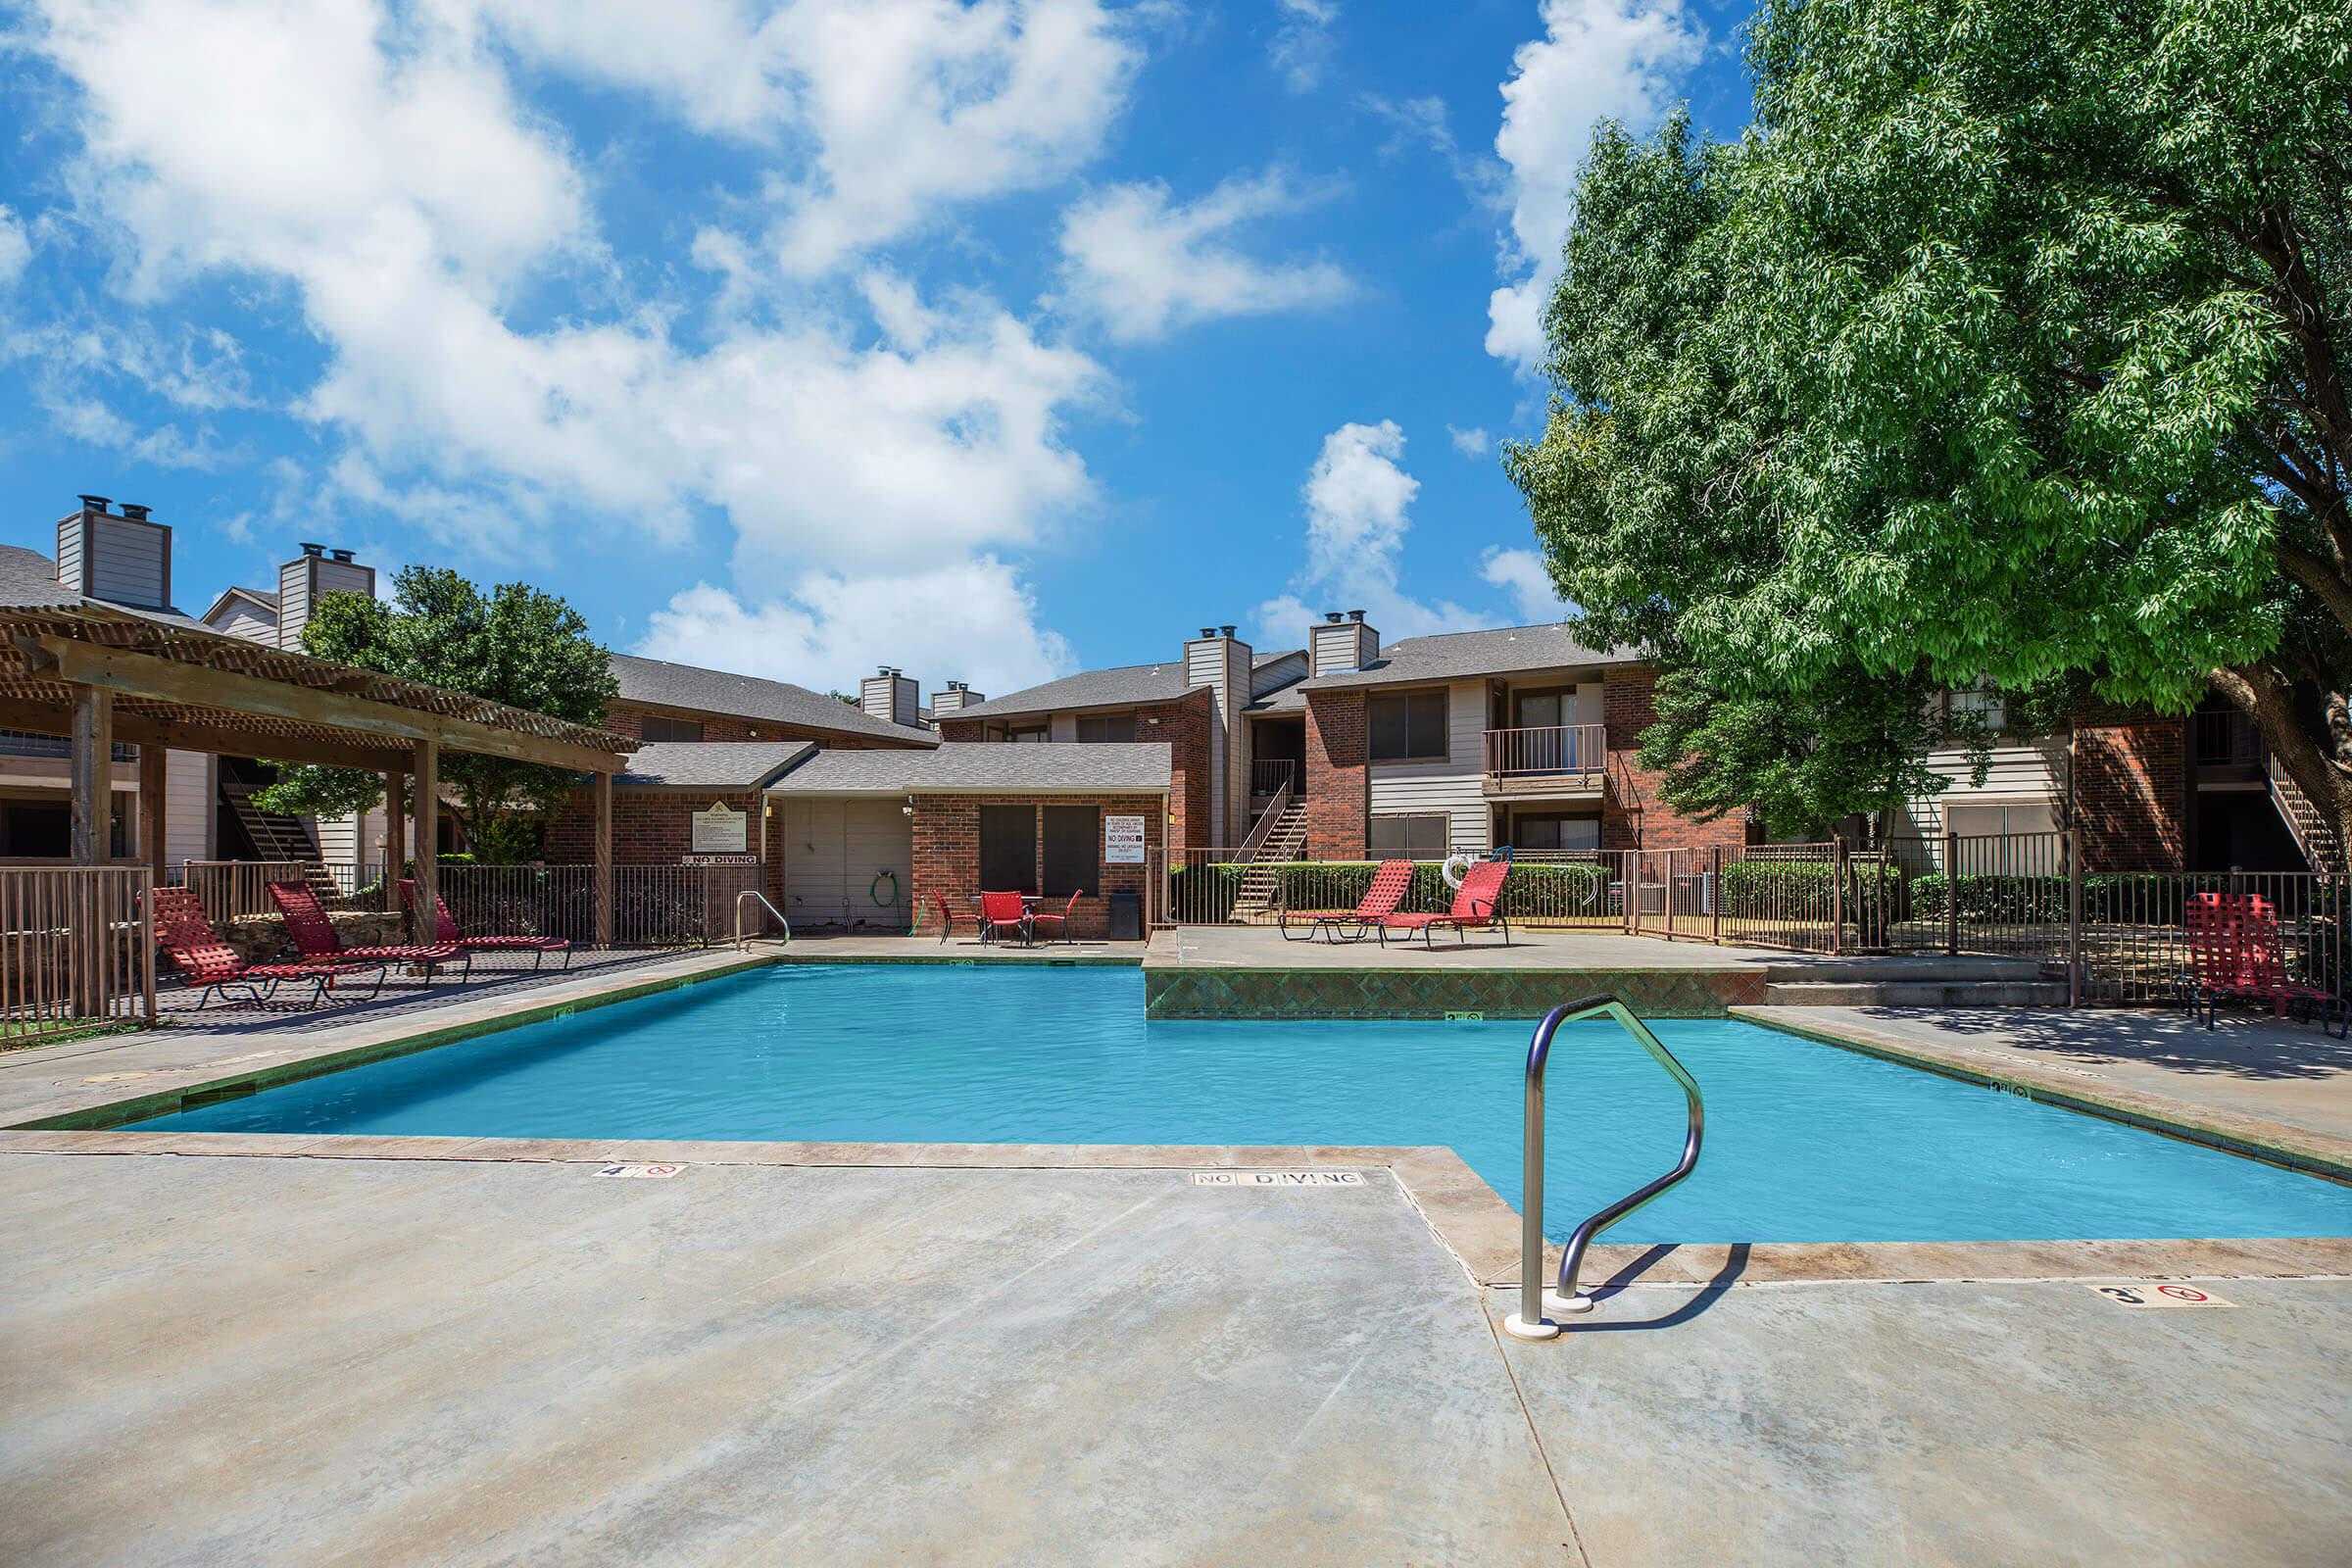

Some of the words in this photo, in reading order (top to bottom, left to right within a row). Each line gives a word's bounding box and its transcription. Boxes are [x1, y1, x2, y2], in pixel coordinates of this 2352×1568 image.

[602, 1166, 625, 1175] 4
[1200, 1175, 1232, 1184] NO
[1255, 1174, 1358, 1184] DIVING
[2099, 1288, 2145, 1304] 3
